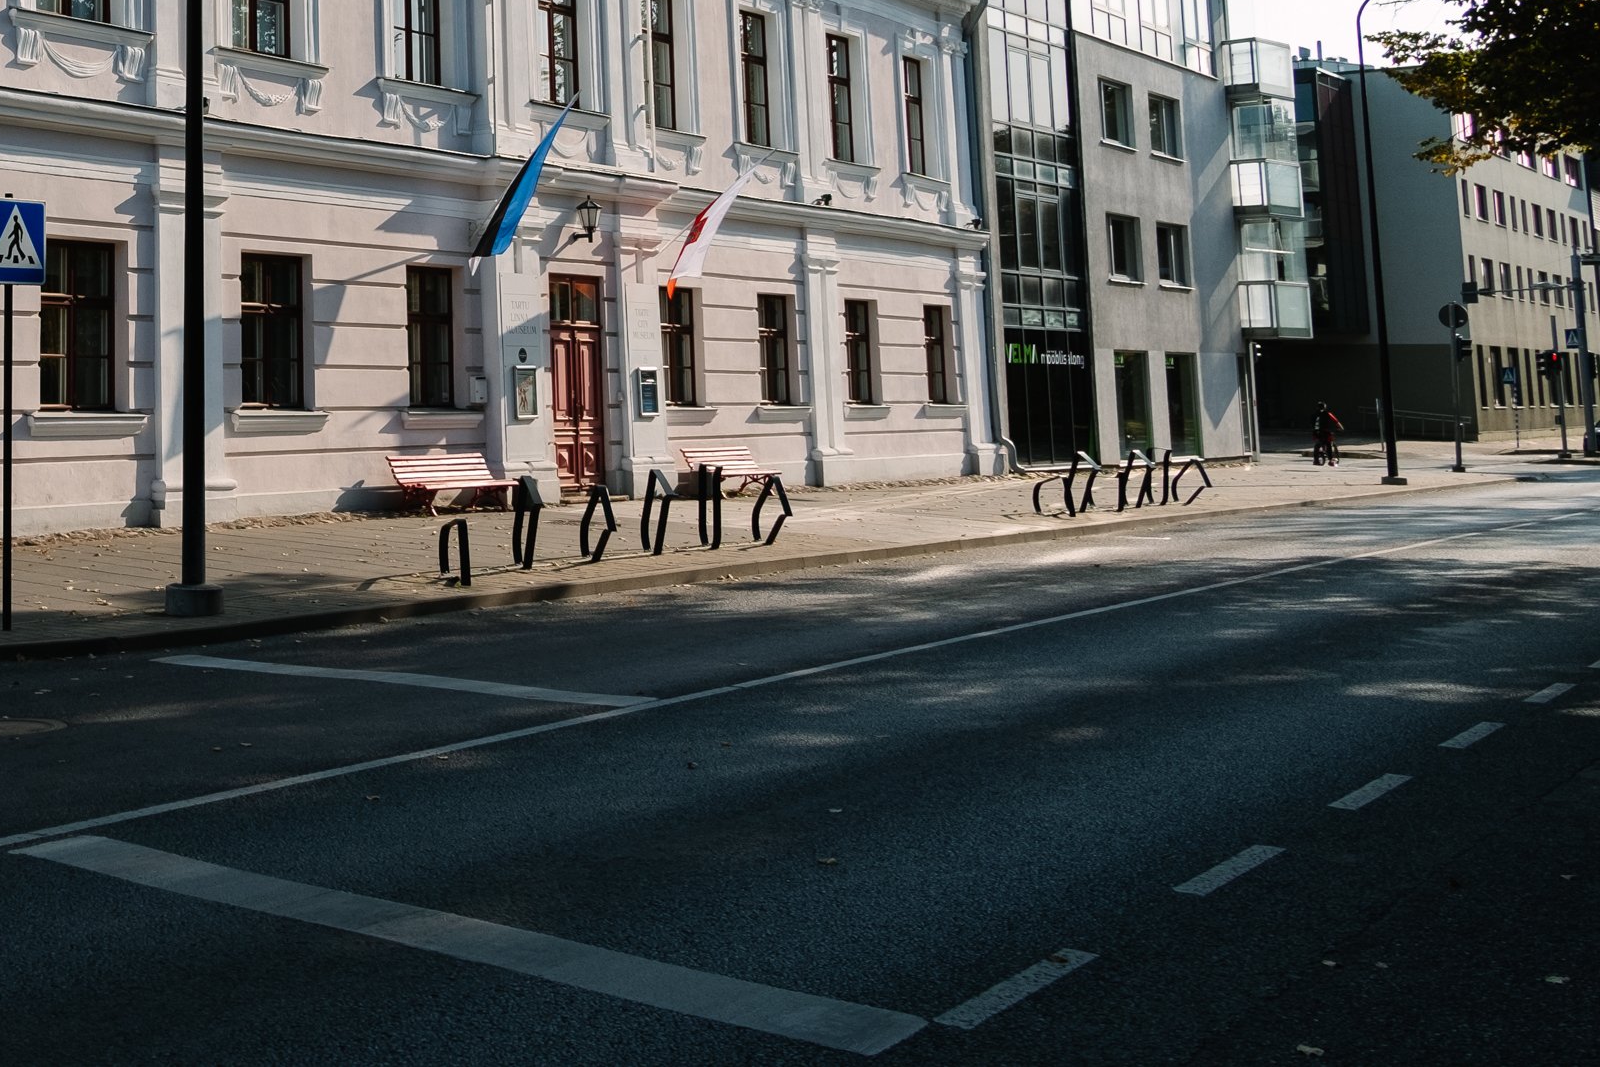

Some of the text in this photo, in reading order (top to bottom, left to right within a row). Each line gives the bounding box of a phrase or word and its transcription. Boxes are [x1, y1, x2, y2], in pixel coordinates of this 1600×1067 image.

[511, 300, 529, 310] TARTU
[634, 308, 650, 317] TARTU
[511, 313, 530, 322] LINNA
[505, 325, 538, 335] MUUSEUM
[632, 331, 656, 340] MUSEUM
[1005, 343, 1039, 364] VELMA
